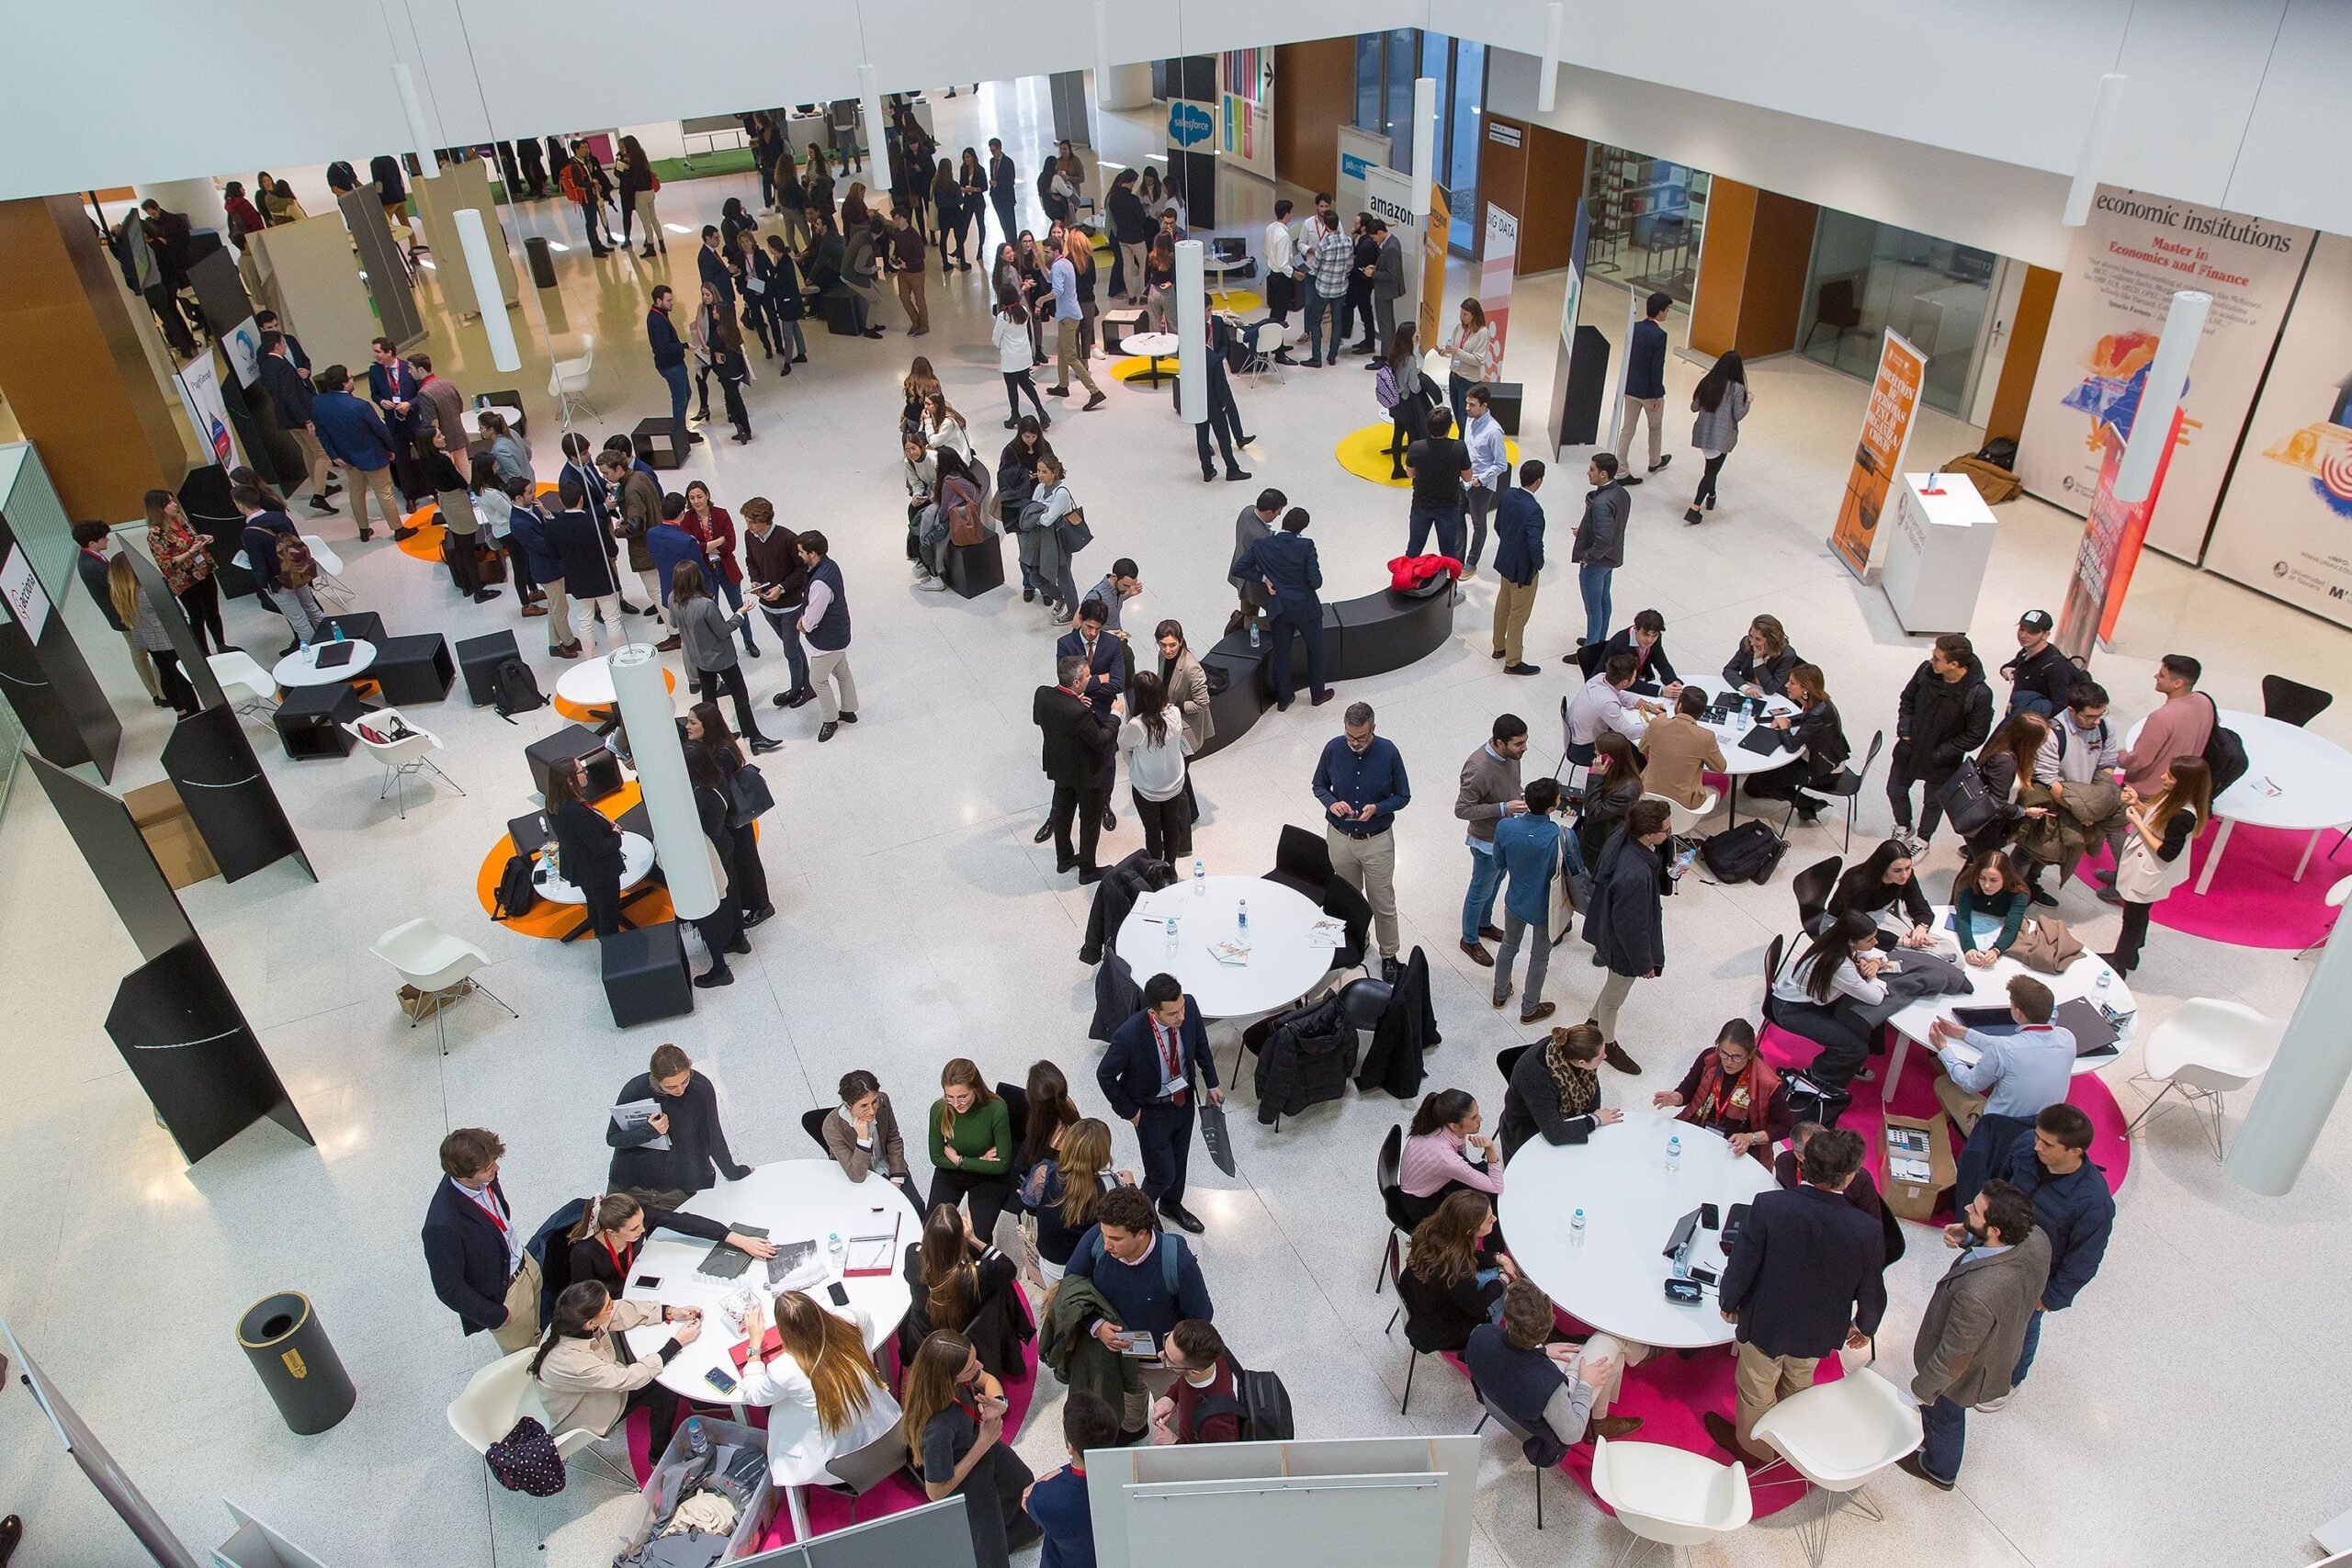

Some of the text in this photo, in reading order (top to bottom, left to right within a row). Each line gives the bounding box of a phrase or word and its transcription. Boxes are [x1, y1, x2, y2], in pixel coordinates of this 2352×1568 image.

[1174, 118, 1209, 131] salesforce
[1370, 195, 1414, 227] amazon
[2097, 194, 2292, 253] economic institutions
[1498, 219, 1515, 241] DATA
[2109, 240, 2250, 288] Economics and Finance
[2152, 236, 2209, 261] Master in
[19, 573, 37, 609] acciona
